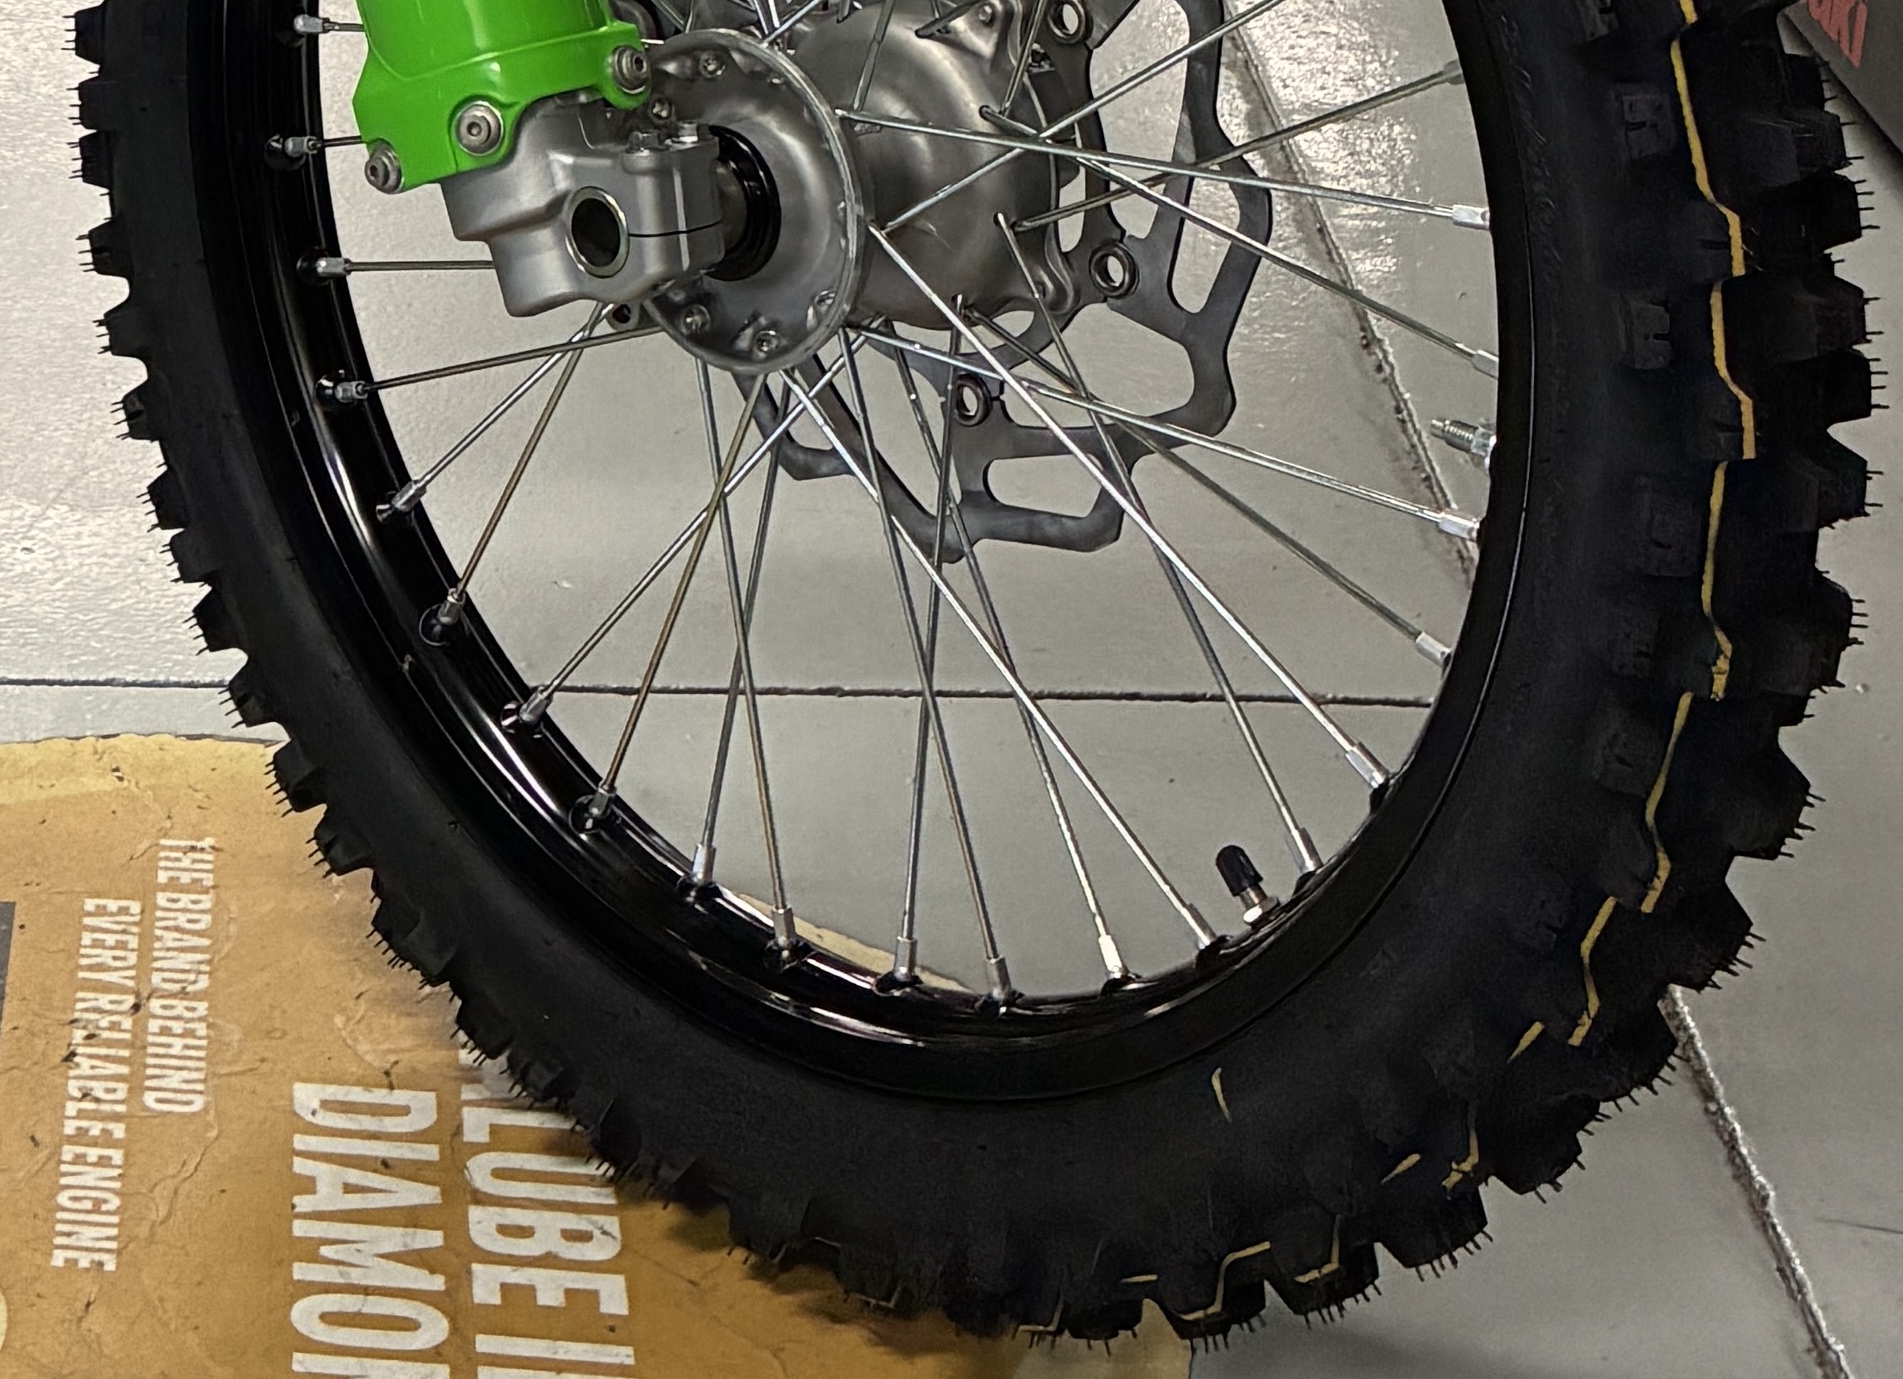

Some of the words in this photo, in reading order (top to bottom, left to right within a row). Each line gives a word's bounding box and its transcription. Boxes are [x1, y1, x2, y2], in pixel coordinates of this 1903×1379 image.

[157, 836, 215, 888] THE
[77, 898, 142, 989] EVERY
[150, 891, 213, 993] BRAND
[63, 991, 135, 1140] RELIABLE
[141, 998, 209, 1113] BEHIND
[50, 1144, 125, 1272] ENGINE
[458, 1036, 630, 1316] LUBE
